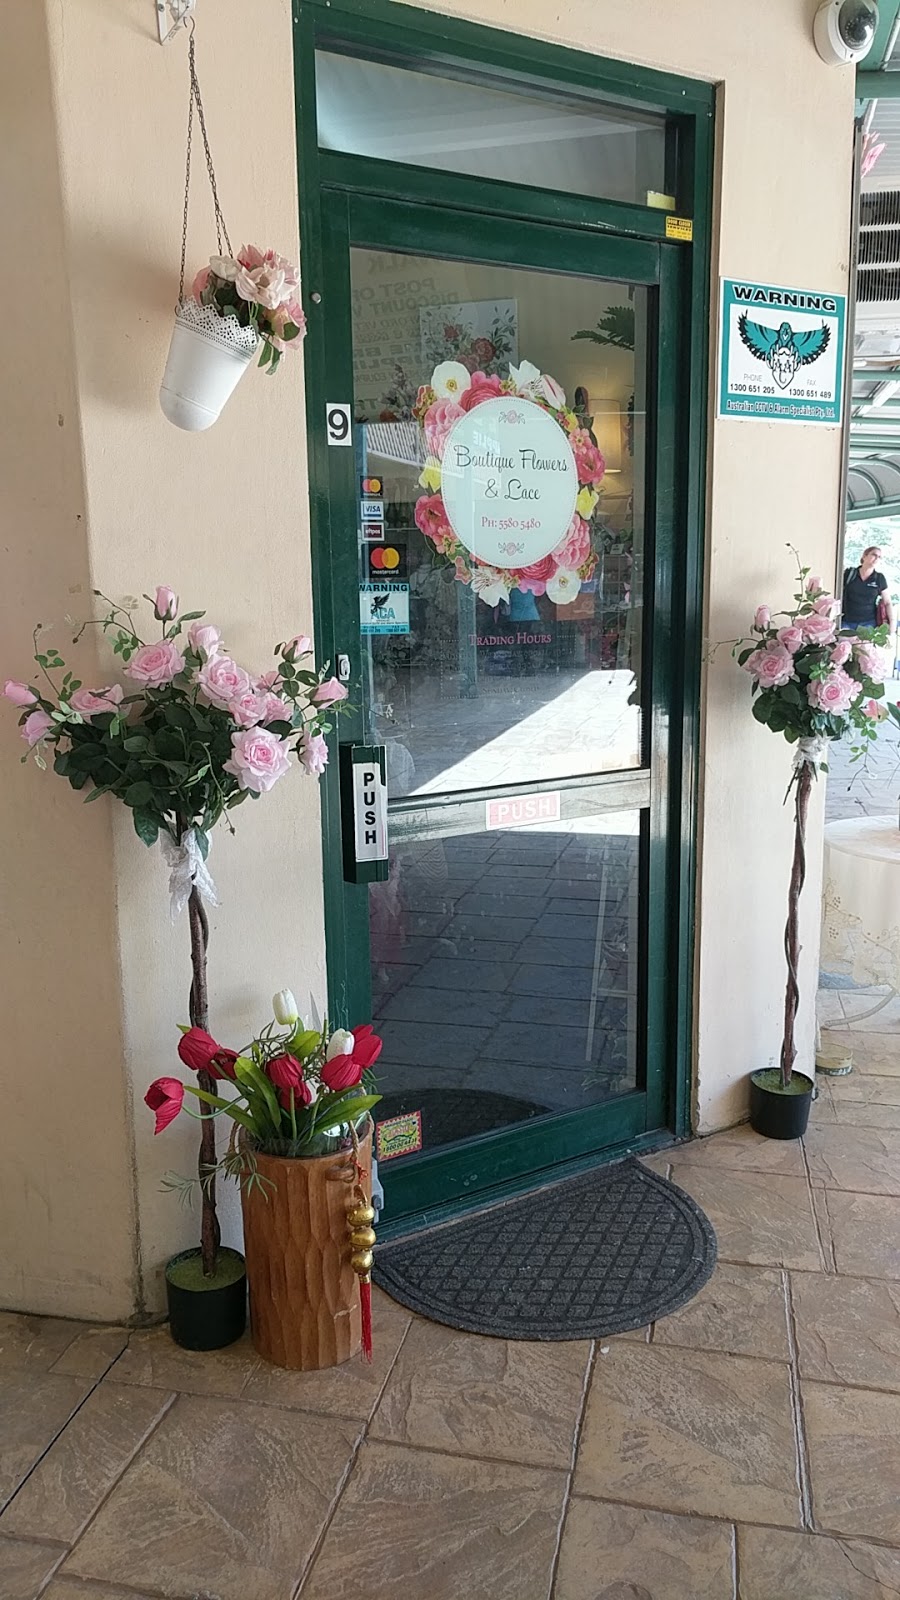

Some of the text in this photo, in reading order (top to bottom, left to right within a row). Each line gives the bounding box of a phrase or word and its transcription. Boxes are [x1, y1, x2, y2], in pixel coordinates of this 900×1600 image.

[733, 286, 836, 311] WARNING
[743, 373, 763, 382] PHONE
[730, 384, 775, 394] 1300 651 205
[789, 388, 832, 399] 1300 651 489
[726, 399, 754, 412] Australian
[755, 400, 768, 412] CCTV
[774, 402, 790, 414] Alarm
[328, 408, 349, 440] 9
[454, 445, 569, 473] Boutique Flowers
[485, 478, 541, 500] & Lace
[366, 505, 380, 513] VISA
[499, 517, 519, 530] 5580
[520, 517, 541, 530] 5480
[363, 772, 376, 844] PUSH
[498, 798, 551, 822] PUSH
